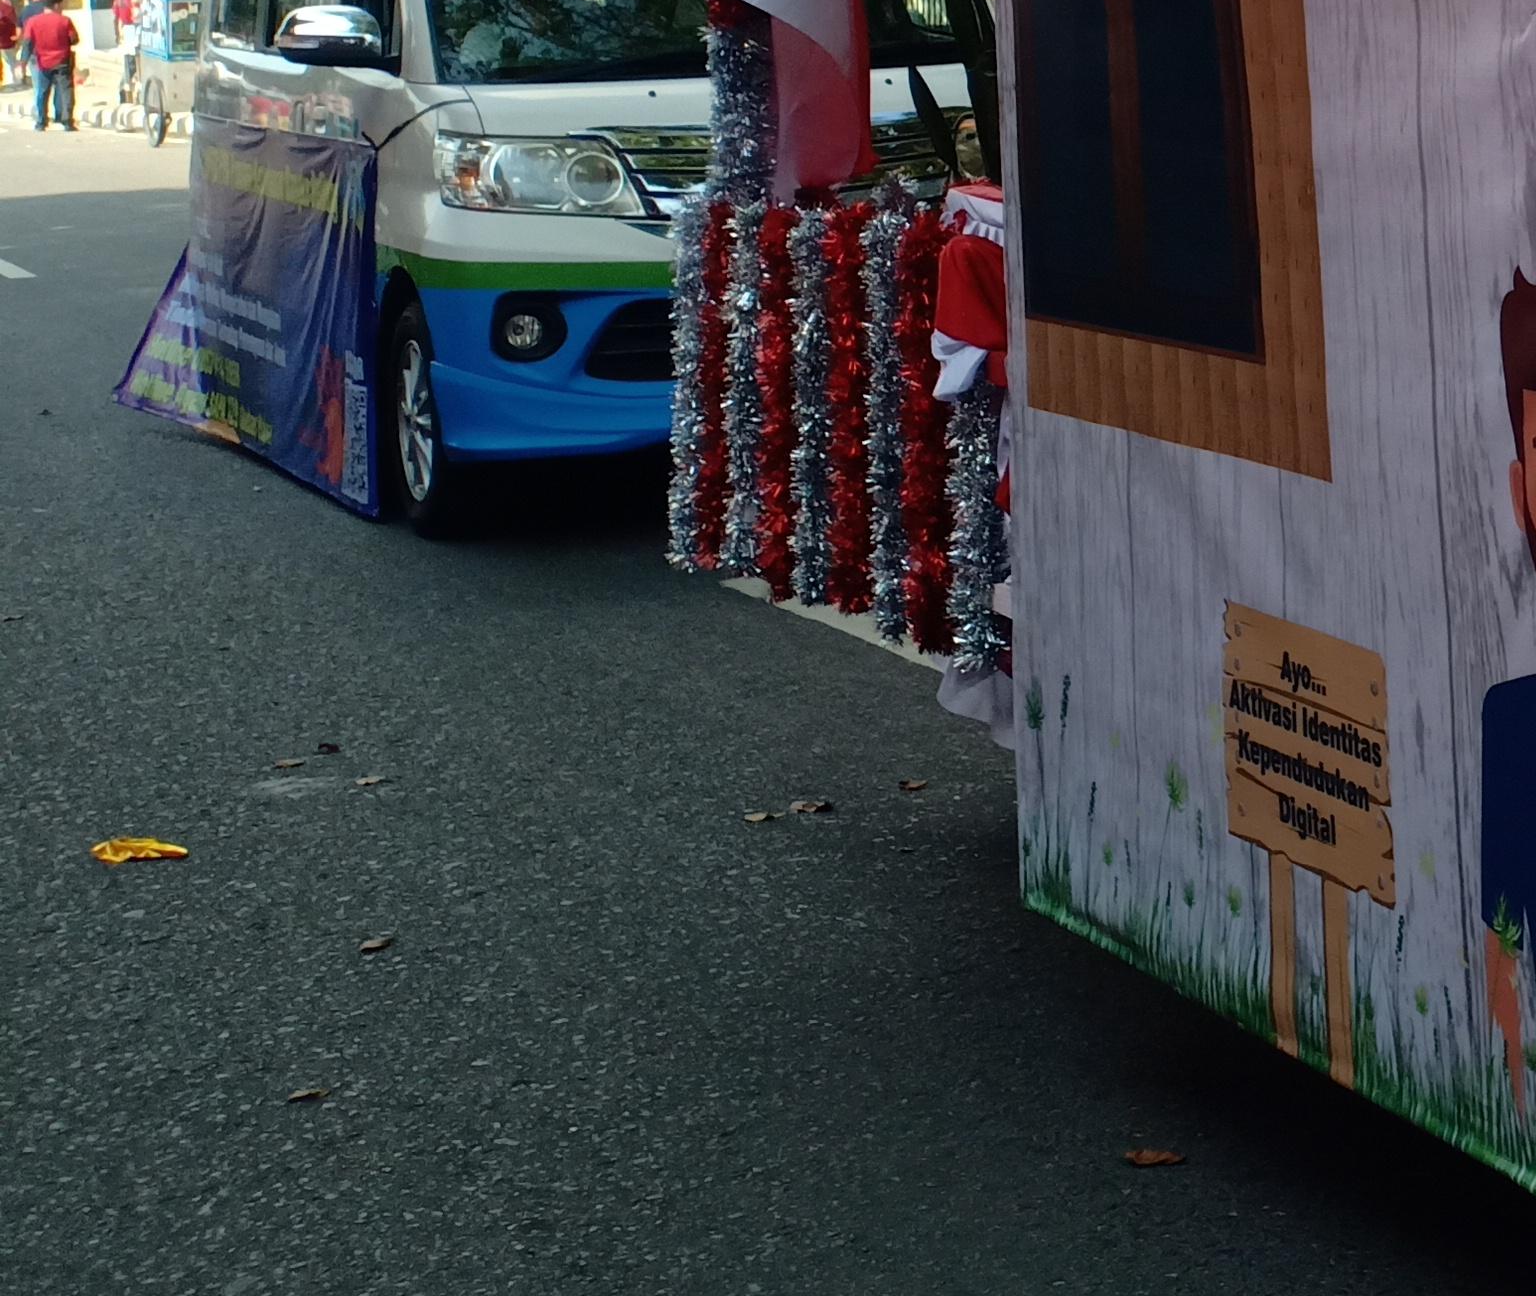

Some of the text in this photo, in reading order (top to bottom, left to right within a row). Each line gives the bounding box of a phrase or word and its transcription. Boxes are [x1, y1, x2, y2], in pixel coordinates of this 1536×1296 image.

[1280, 651, 1327, 696] Ayo...
[1229, 678, 1382, 768] Aktivasi Identitas
[1238, 728, 1370, 812] Kependudukan
[1278, 794, 1337, 846] Digital
